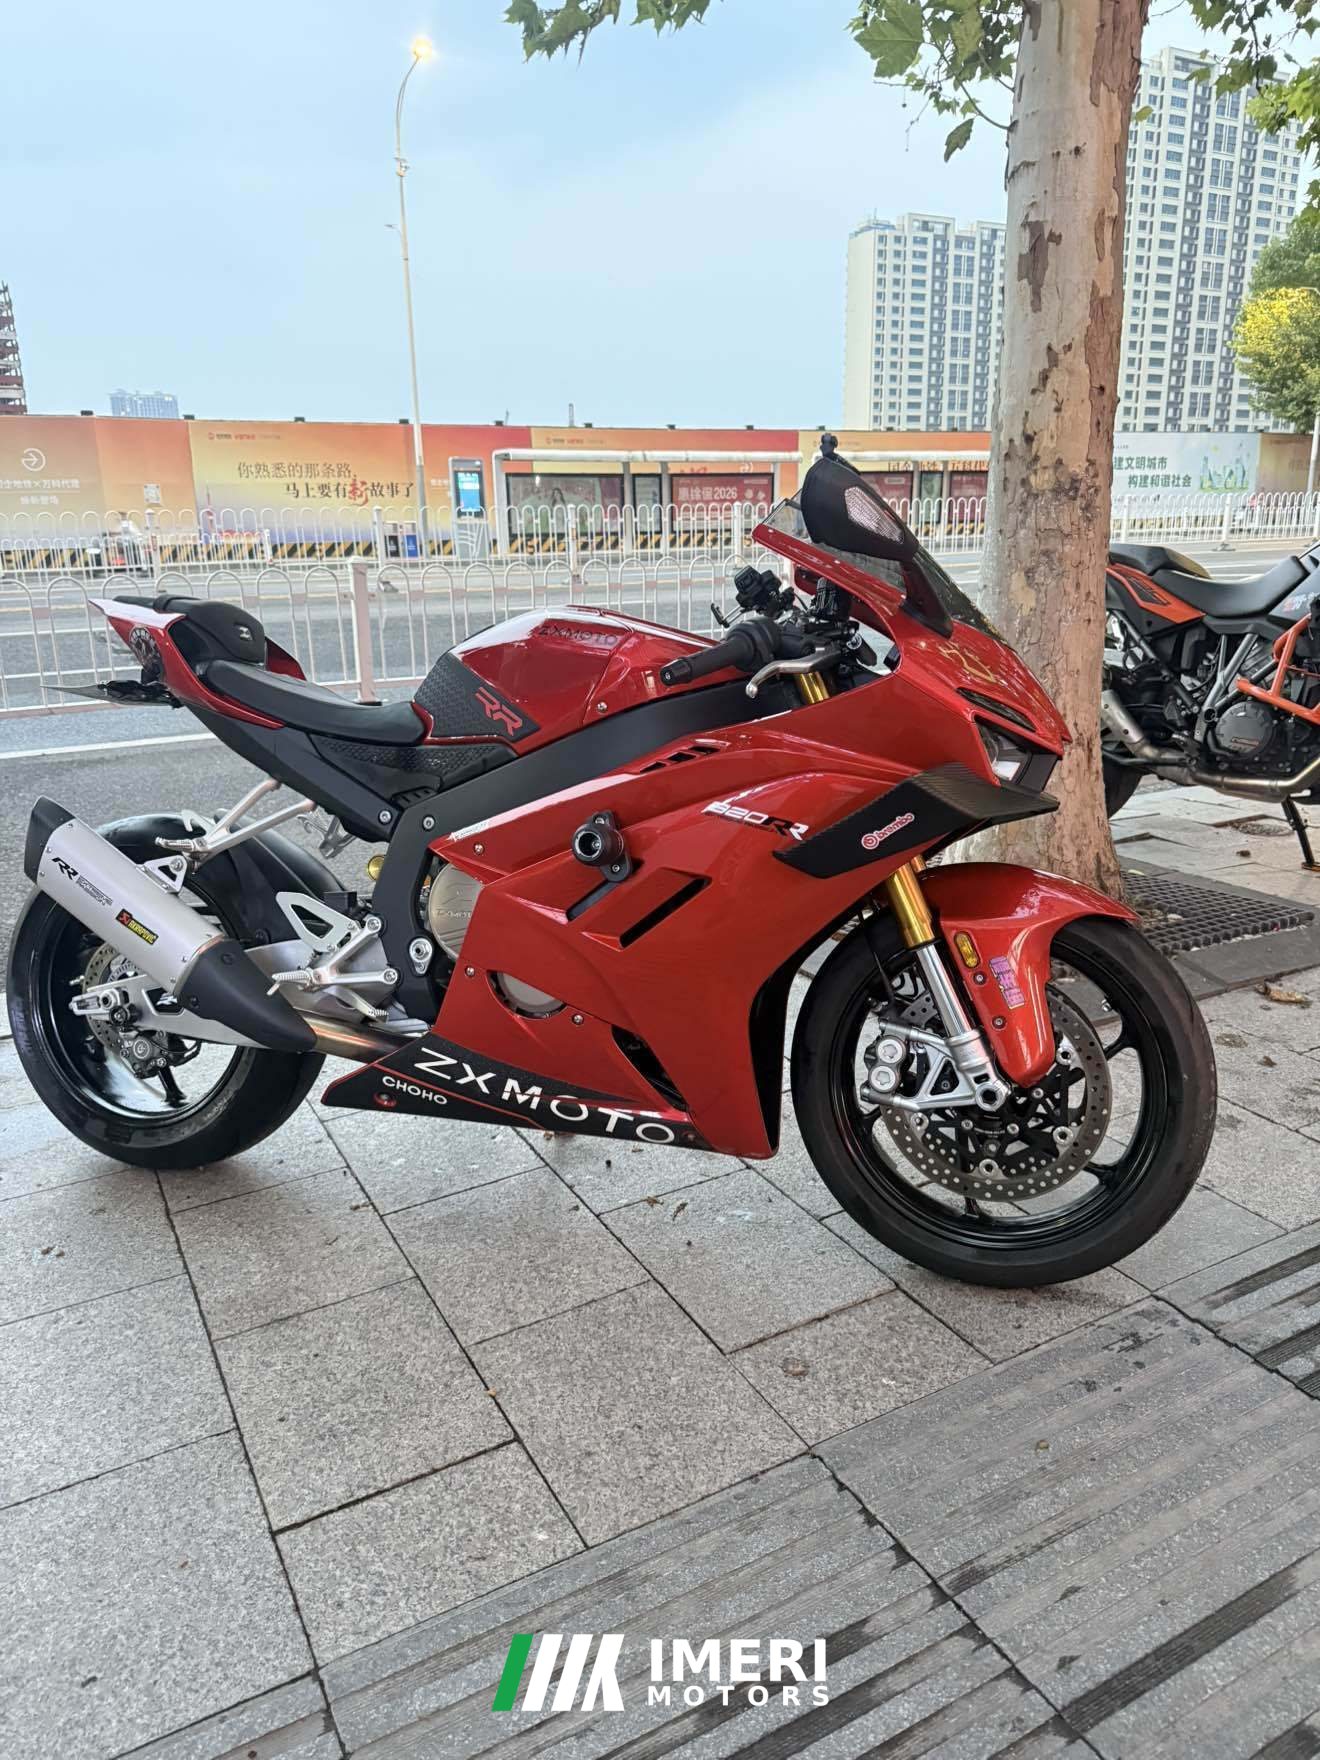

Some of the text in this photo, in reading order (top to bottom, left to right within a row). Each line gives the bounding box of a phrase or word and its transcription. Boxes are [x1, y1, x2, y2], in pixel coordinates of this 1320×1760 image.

[285, 478, 415, 507] 马上要有新故事了
[1128, 474, 1193, 488] 构建和谐社会
[537, 624, 619, 646] ZXMOTO
[873, 812, 915, 842] brembo
[381, 1075, 448, 1105] CHOHO
[413, 1046, 676, 1145] ZXMOTO
